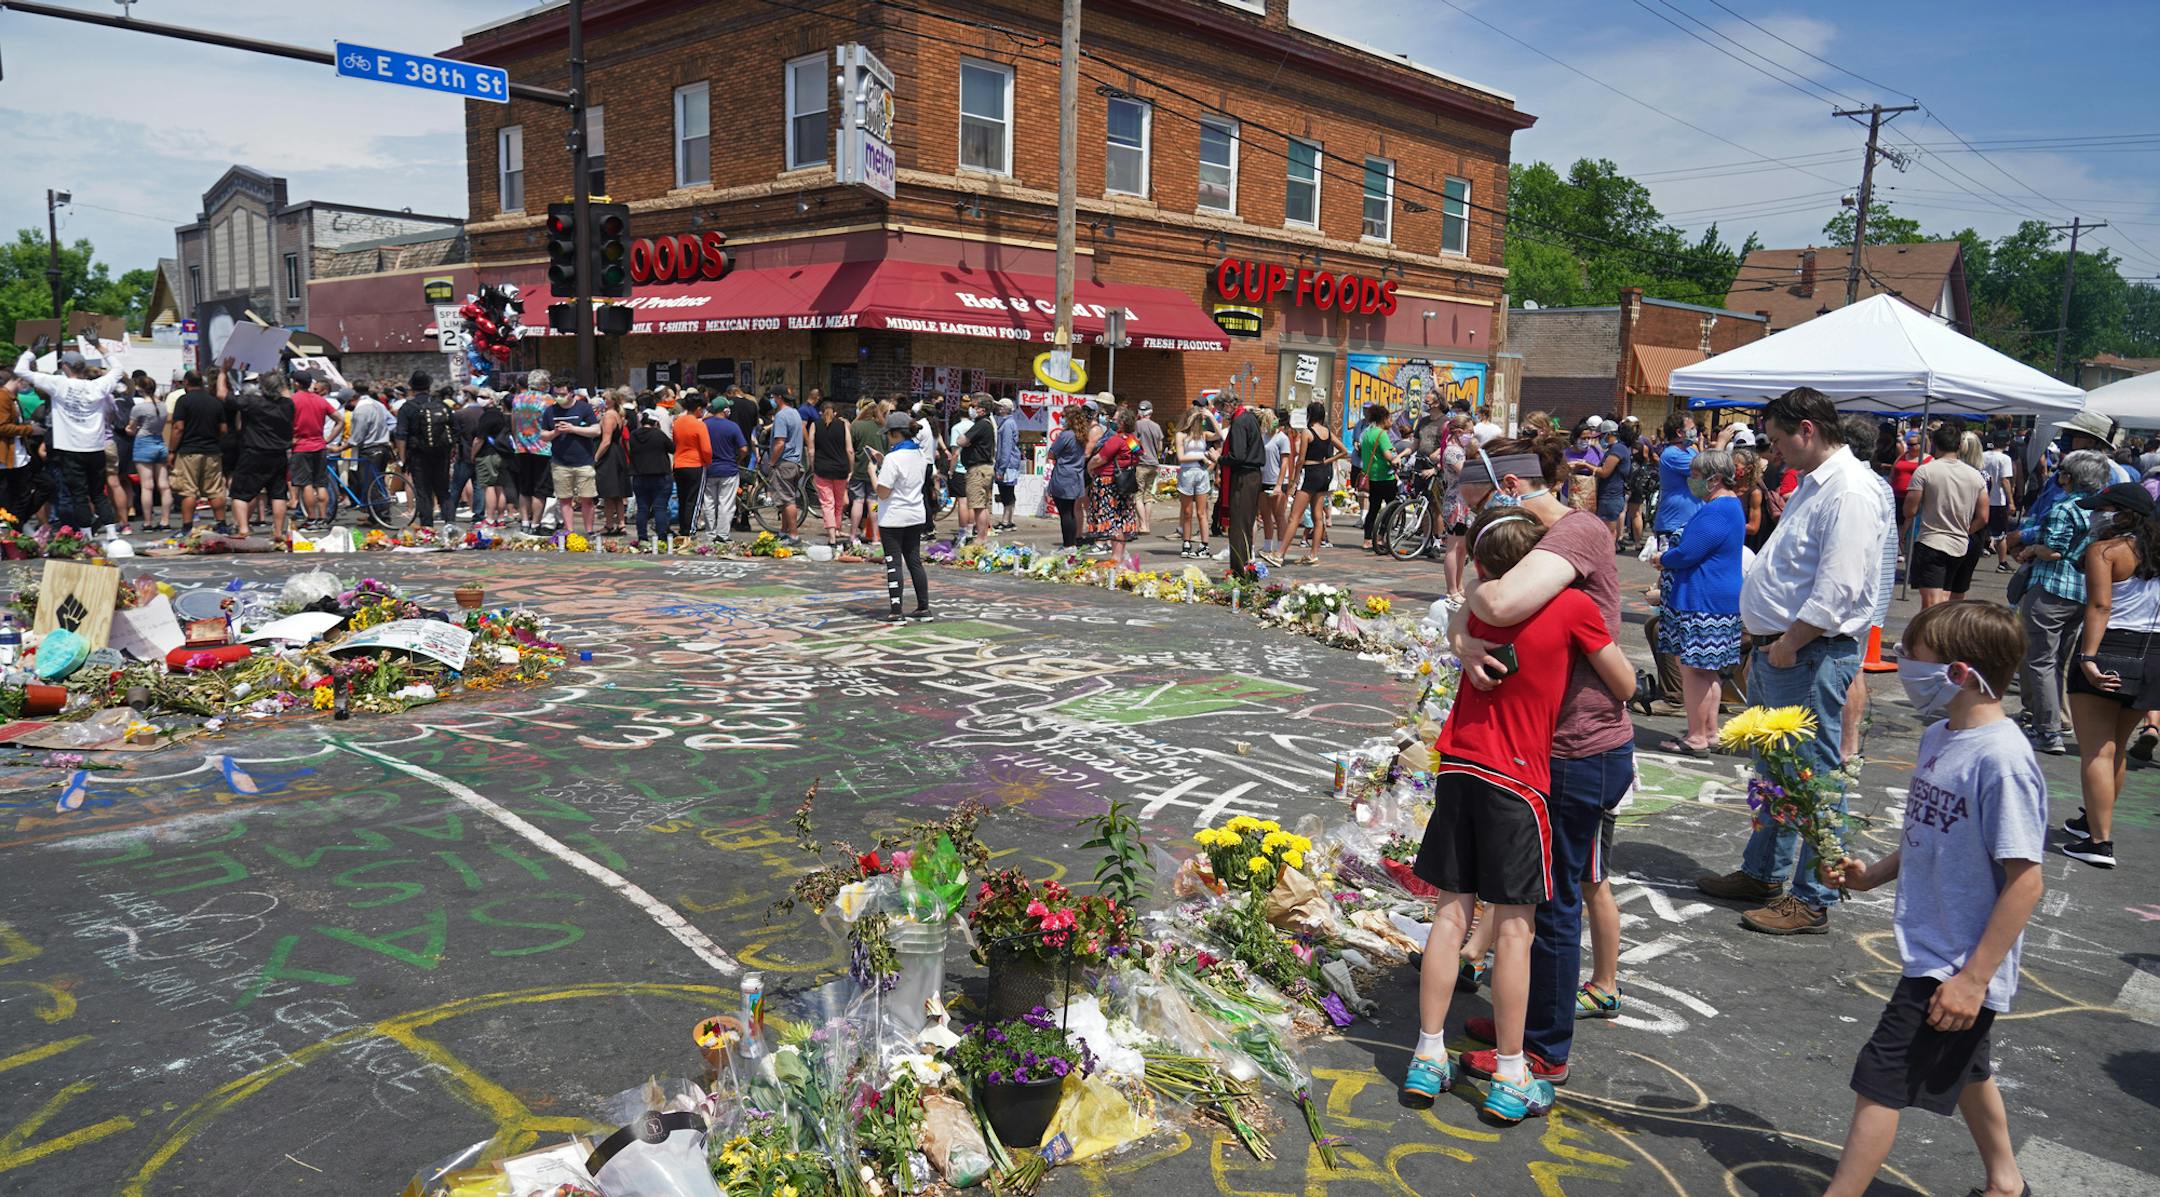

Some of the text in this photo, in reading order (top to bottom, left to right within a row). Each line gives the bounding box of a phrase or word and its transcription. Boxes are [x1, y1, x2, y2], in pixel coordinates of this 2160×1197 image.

[377, 56, 502, 95] E 38th St
[865, 142, 894, 181] metro
[630, 231, 727, 283] OODS
[639, 294, 712, 310] Produce
[956, 292, 1008, 312] Hot
[1009, 297, 1031, 313] &
[1034, 298, 1091, 318] Cld
[1218, 257, 1399, 317] CUP FOODS
[658, 320, 699, 333] T-SHIRTS
[705, 318, 750, 331] MEXICAN
[751, 317, 780, 330] FOOD
[788, 315, 822, 328] HALAL
[825, 313, 858, 327] MEAT
[885, 316, 938, 333] MIDDLE
[939, 321, 997, 338] EASTERN
[999, 325, 1031, 341] FOOD
[1043, 332, 1083, 345] CSE
[1143, 337, 1175, 349] FRESH
[1177, 338, 1223, 351] PRODUCE
[1051, 394, 1065, 406] IN
[1349, 367, 1405, 431] GEORGE
[885, 555, 901, 605] PINK
[1904, 796, 1959, 834] CKEY
[1909, 776, 1969, 818] NESOTA
[234, 893, 588, 1011] SAY
[276, 994, 452, 1094] GEORGE
